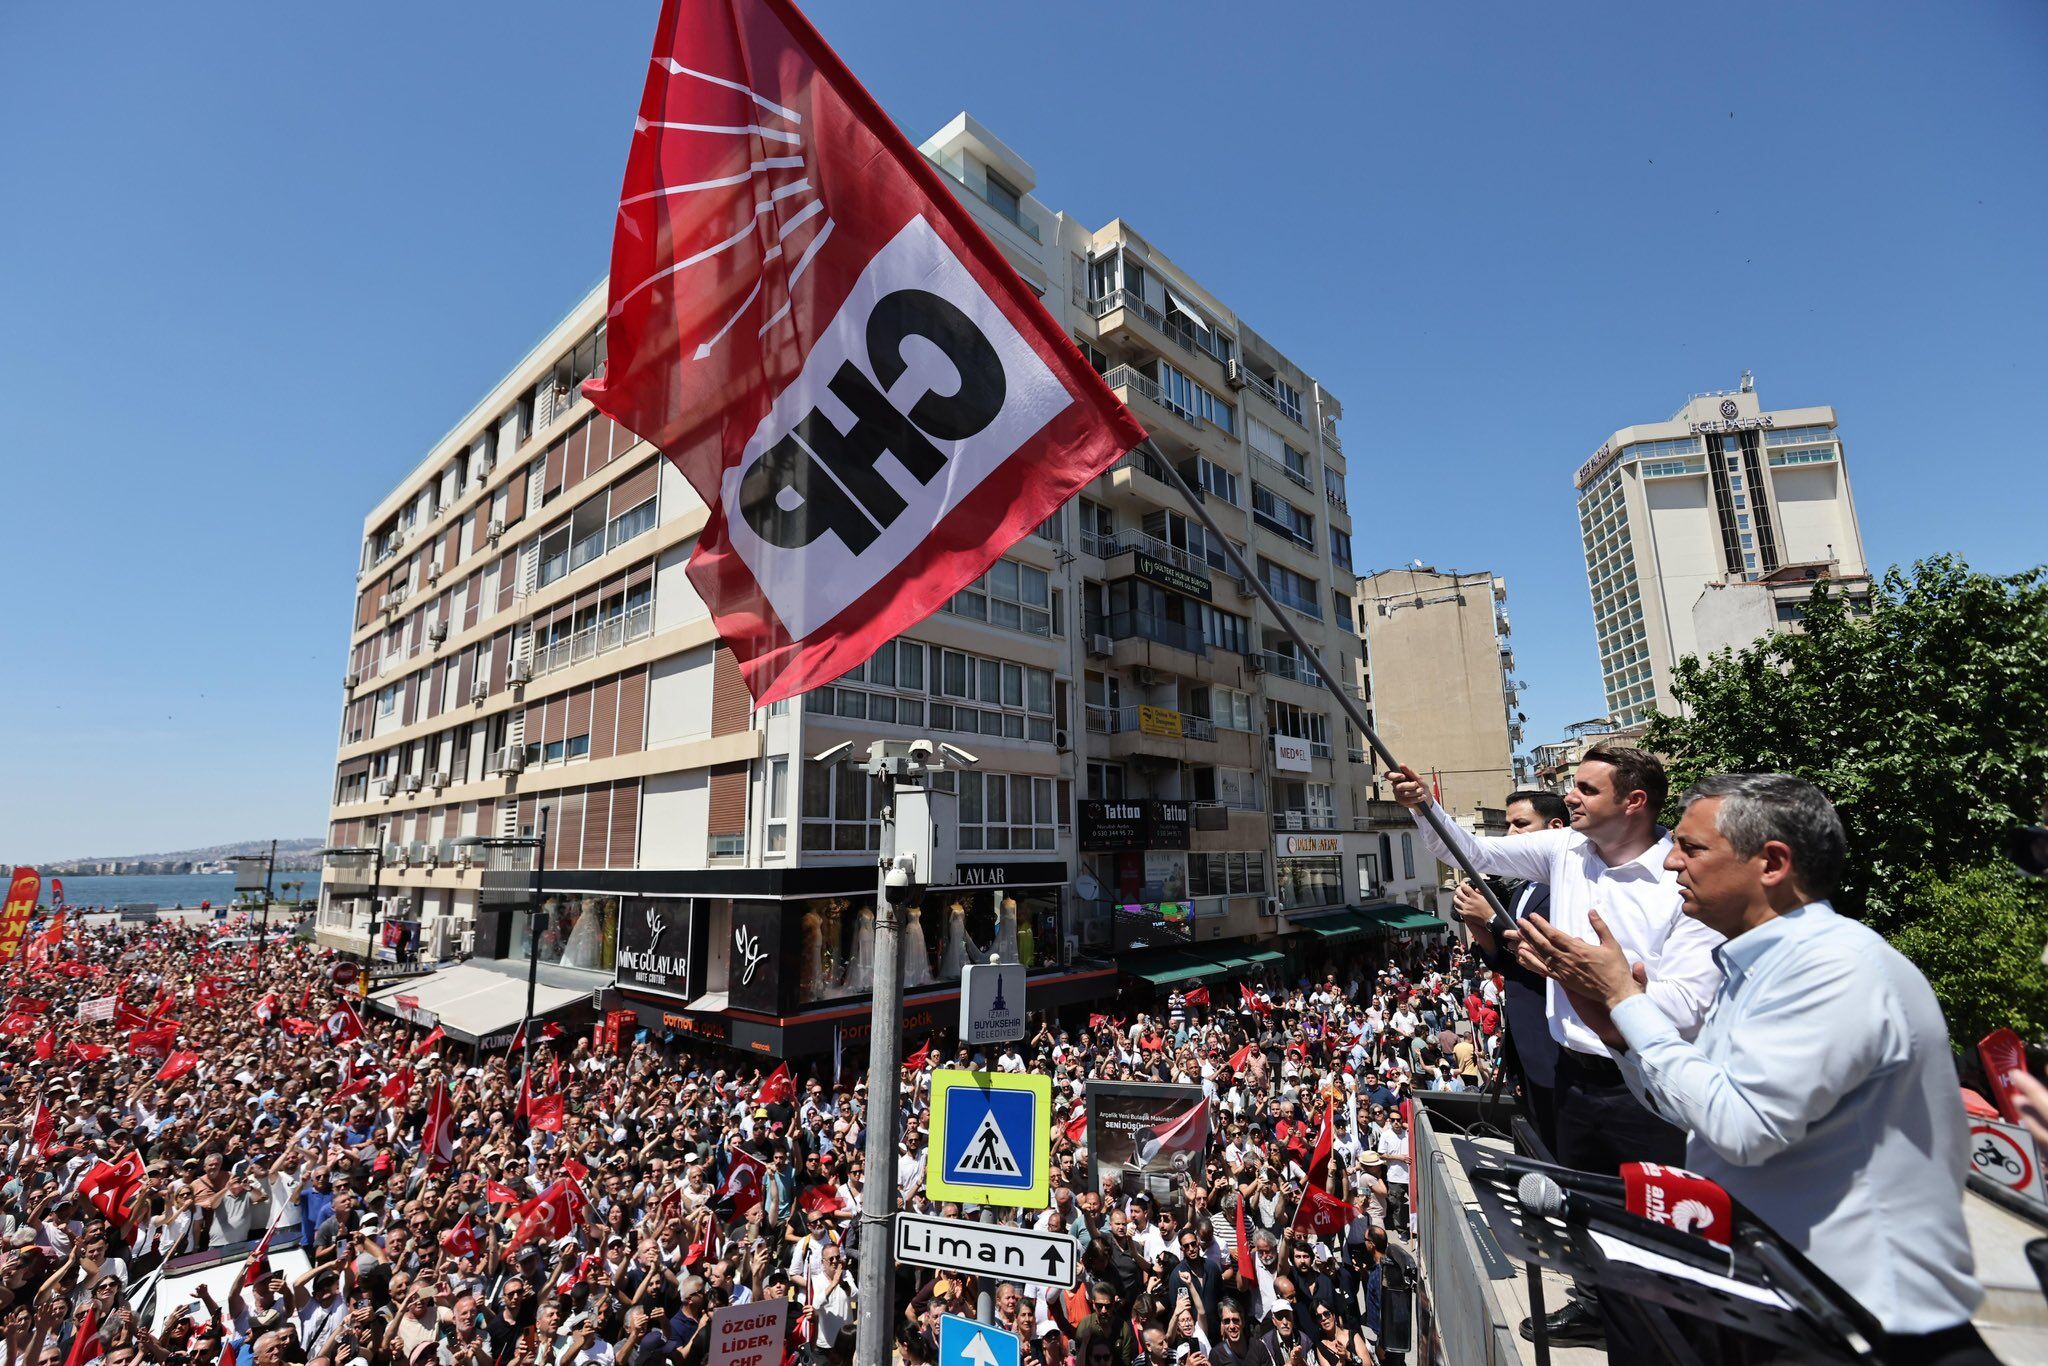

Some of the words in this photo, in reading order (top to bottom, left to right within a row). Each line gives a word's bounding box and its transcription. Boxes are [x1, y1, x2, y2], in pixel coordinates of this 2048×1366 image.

[1689, 420, 1718, 433] EGE
[1723, 416, 1774, 430] PALAS
[1104, 804, 1140, 819] Tattoo
[1162, 804, 1187, 821] Tattoo
[618, 945, 639, 970] MİNE
[639, 948, 686, 977] GÜLAYLAR
[635, 971, 648, 982] HAUTE
[649, 973, 666, 986] COUTURE
[903, 1011, 933, 1030] optik
[480, 1033, 514, 1050] KUMR
[1099, 1111, 1118, 1119] Arçelik
[1105, 1120, 1121, 1129] SENİ
[904, 1224, 1024, 1267] Liman
[721, 1313, 778, 1335] ÖZGÜR
[721, 1334, 773, 1354] LİDER,
